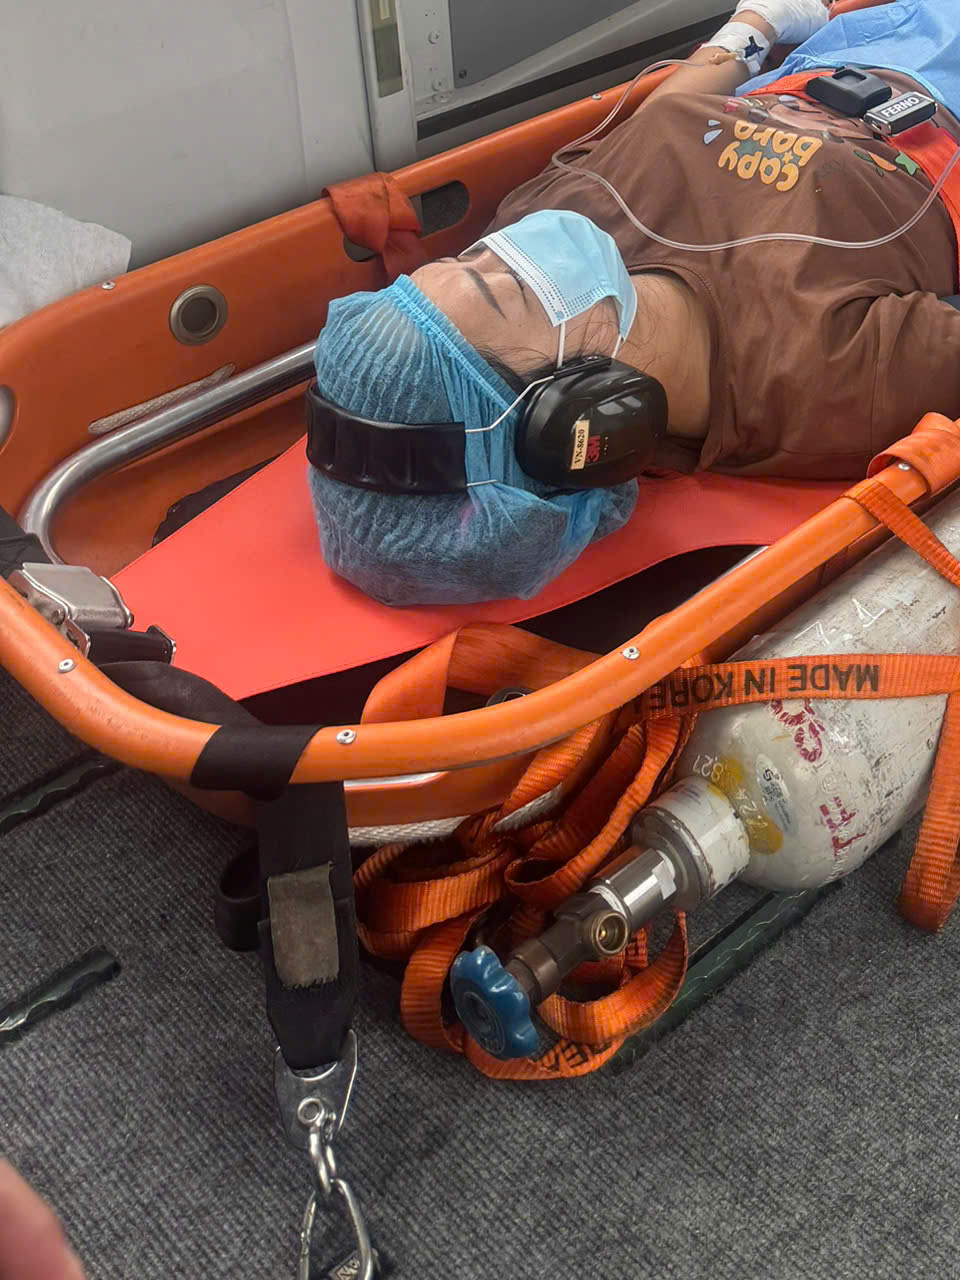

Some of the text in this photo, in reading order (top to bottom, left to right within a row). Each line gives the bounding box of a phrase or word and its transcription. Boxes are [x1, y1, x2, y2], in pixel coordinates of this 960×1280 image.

[881, 95, 920, 117] FERNO
[574, 428, 585, 464] VN-8620
[744, 666, 775, 696] IN
[788, 663, 880, 693] MADE
